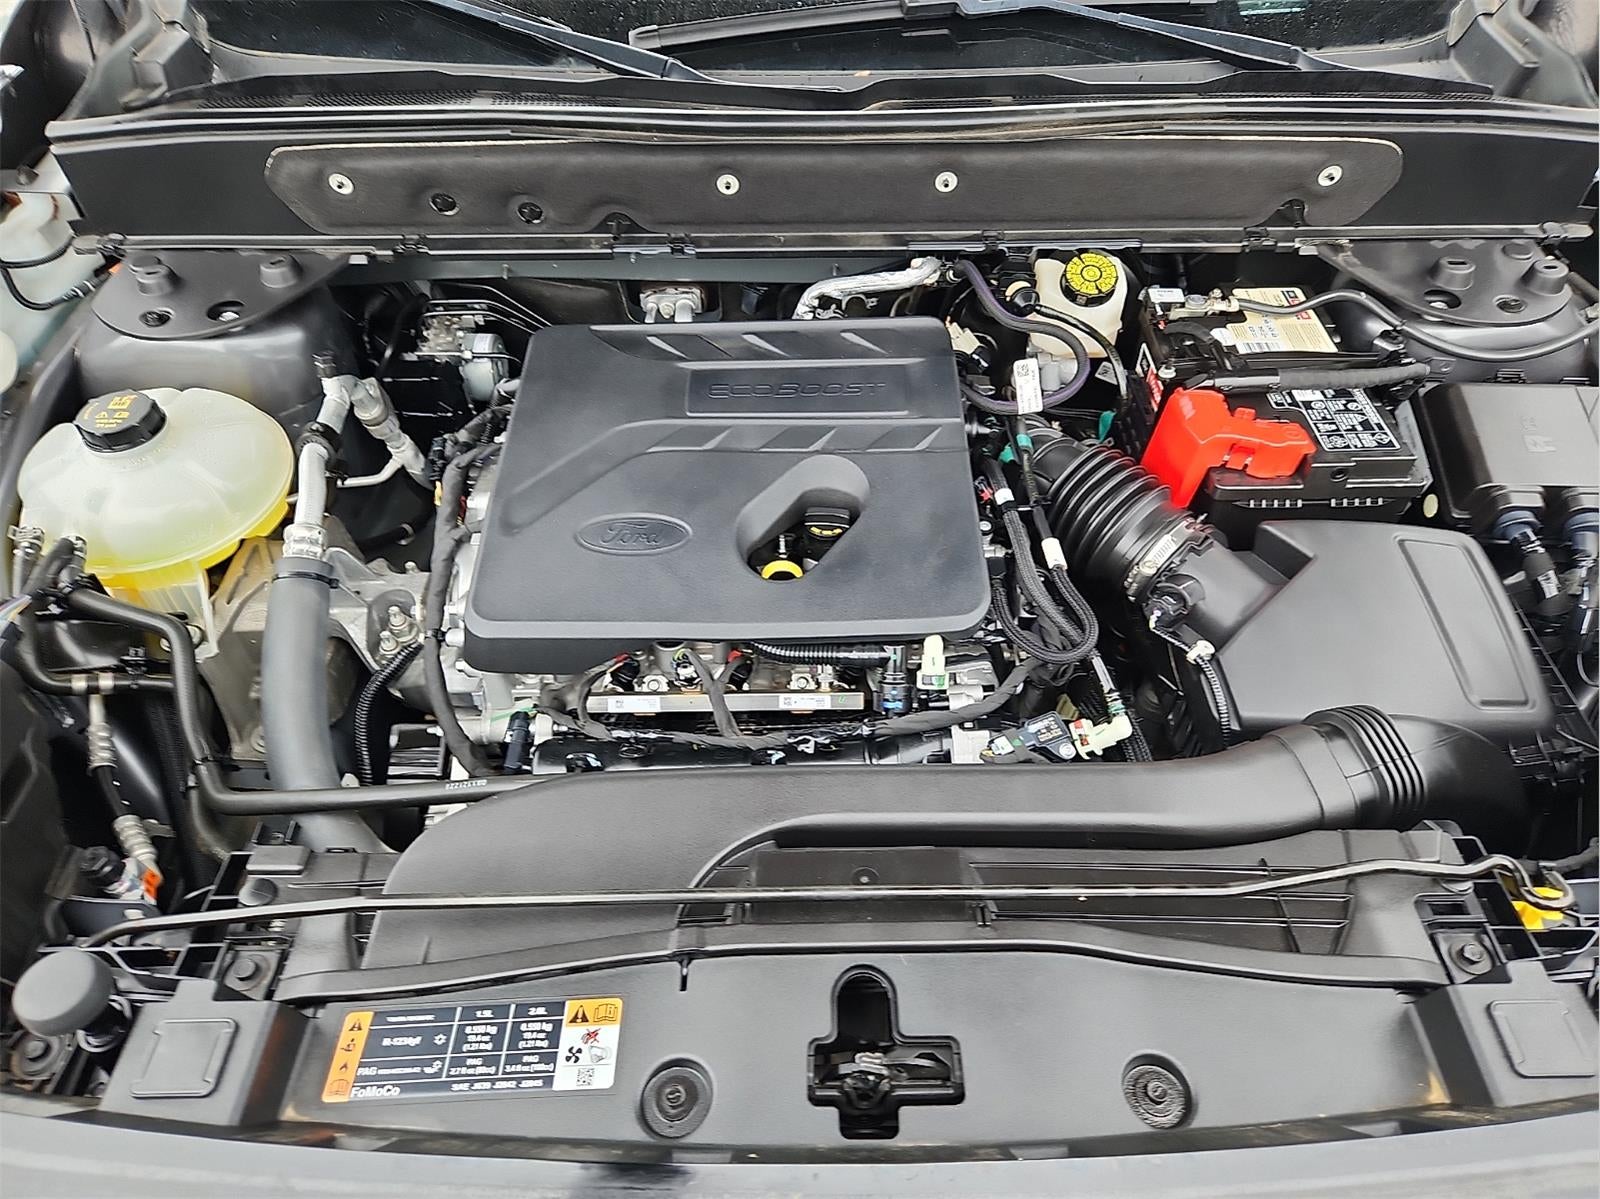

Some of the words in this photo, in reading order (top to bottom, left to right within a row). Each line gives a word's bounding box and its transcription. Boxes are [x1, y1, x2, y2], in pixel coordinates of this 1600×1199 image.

[600, 522, 664, 546] Ford
[356, 1066, 378, 1076] PAG
[350, 1085, 400, 1098] FoMoCo
